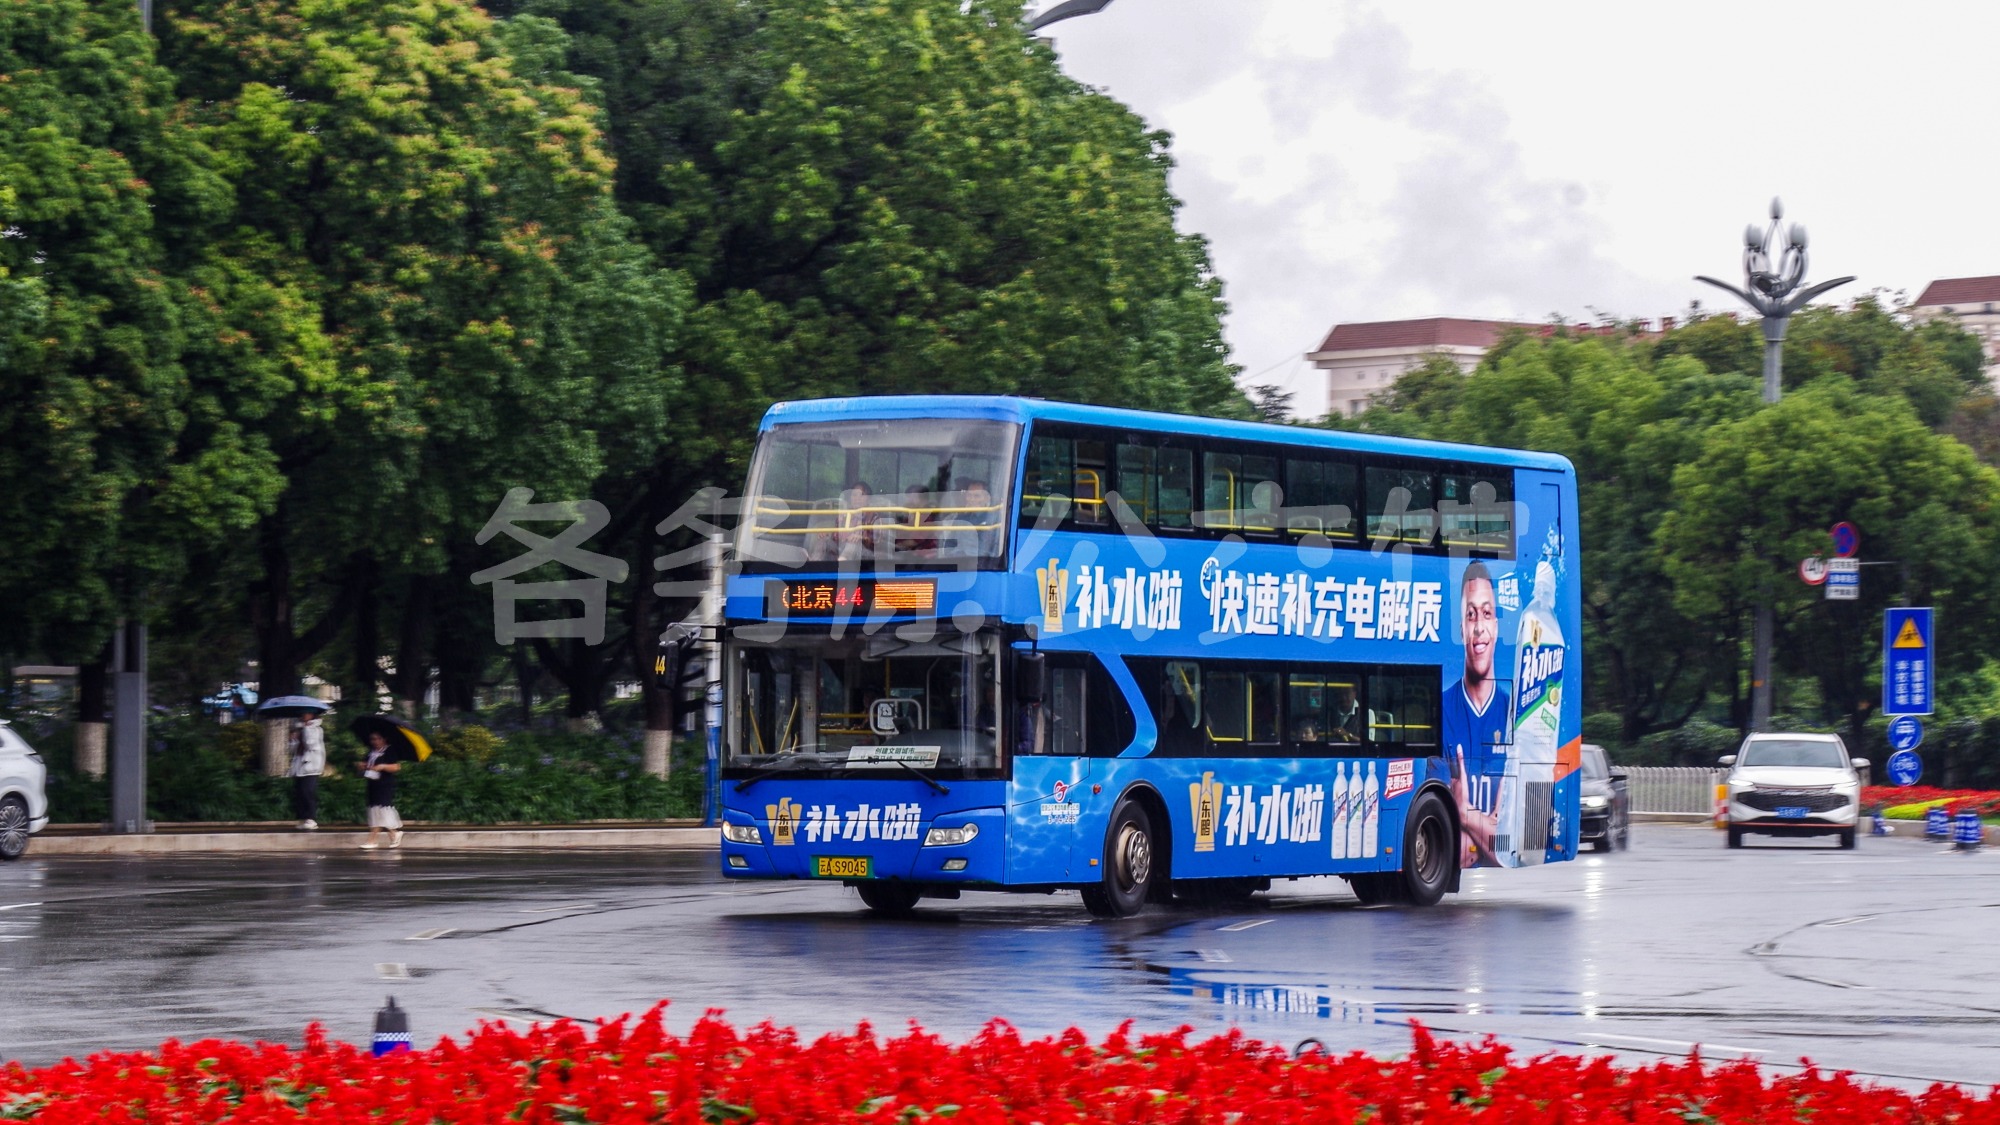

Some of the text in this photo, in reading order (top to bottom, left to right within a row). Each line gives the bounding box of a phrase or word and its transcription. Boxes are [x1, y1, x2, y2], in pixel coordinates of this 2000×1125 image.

[1075, 565, 1183, 630] 补水啦
[1208, 568, 1442, 643] 快速补充电解质
[655, 655, 666, 675] 44
[1521, 648, 1564, 692] 补水啦
[778, 814, 789, 836] 东鹏
[804, 803, 922, 843] 补水啦
[1201, 800, 1211, 836] 东鹏
[1224, 784, 1325, 846] 补水啦
